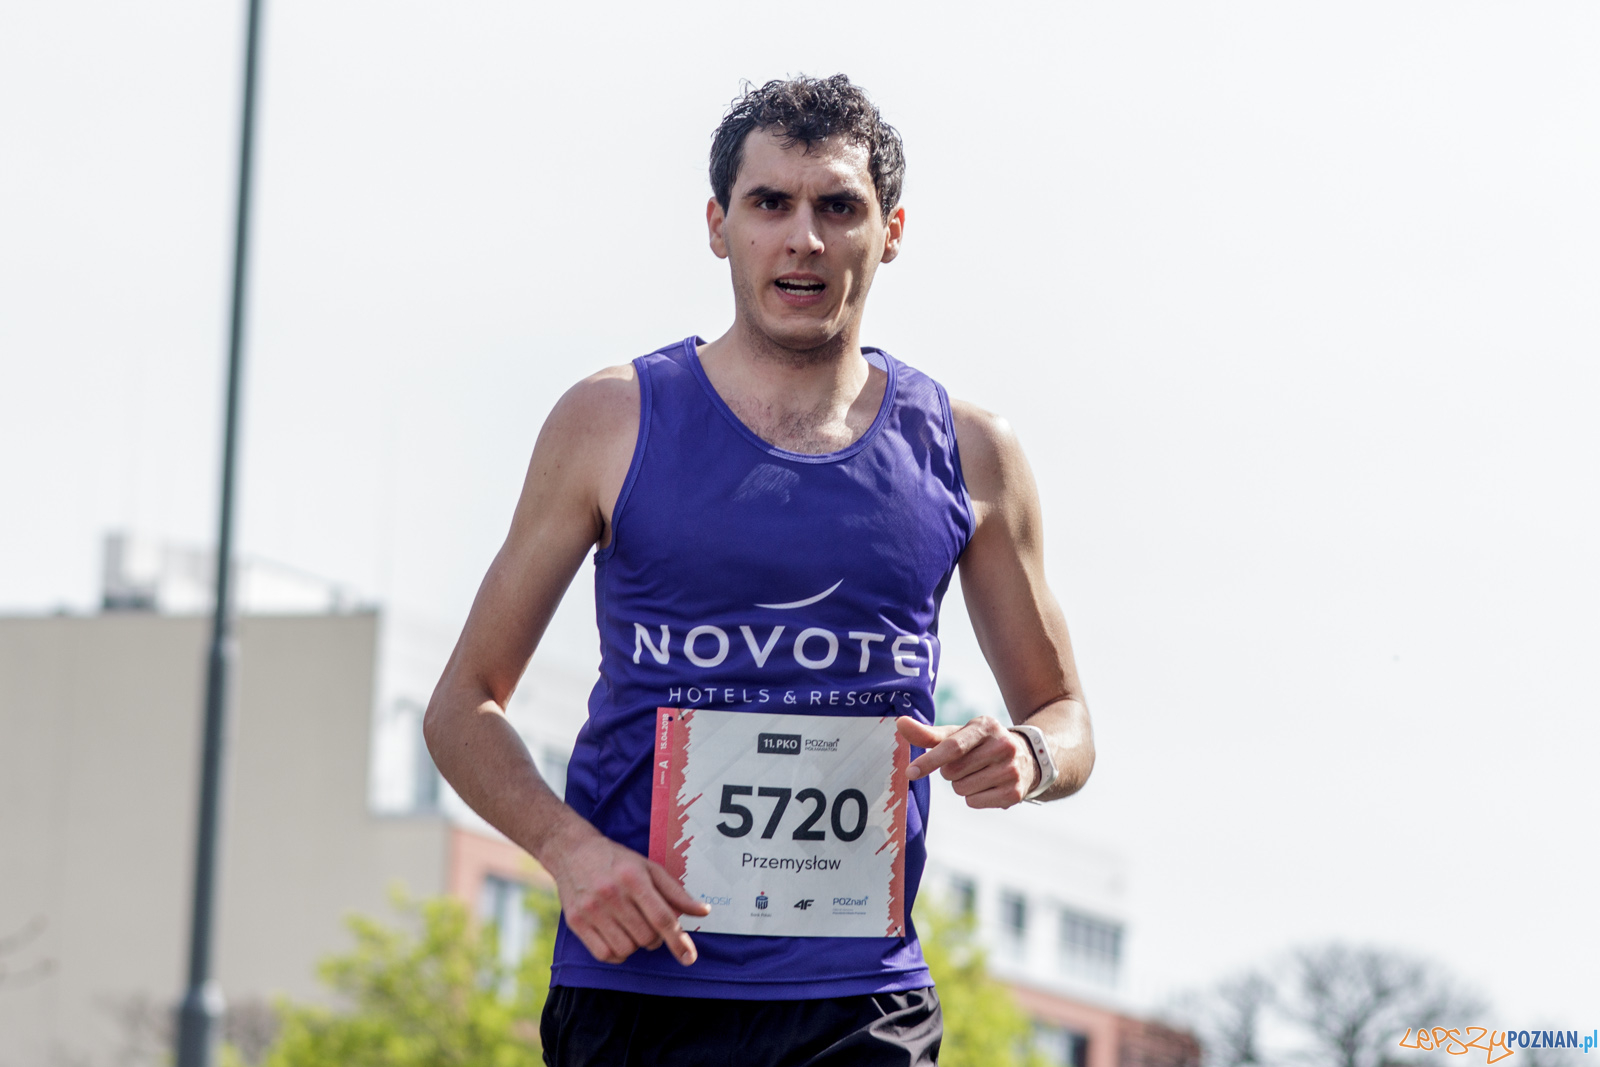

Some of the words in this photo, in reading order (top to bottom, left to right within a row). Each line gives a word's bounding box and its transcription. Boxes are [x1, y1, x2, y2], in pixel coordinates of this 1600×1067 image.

[632, 622, 935, 681] NOVOTEL
[668, 687, 770, 703] HOTELS
[783, 691, 797, 704] &
[660, 713, 669, 750] 15.04.2018
[659, 760, 669, 769] A
[716, 784, 869, 842] 5720
[742, 853, 842, 873] Przemysław
[793, 899, 815, 910] 4F
